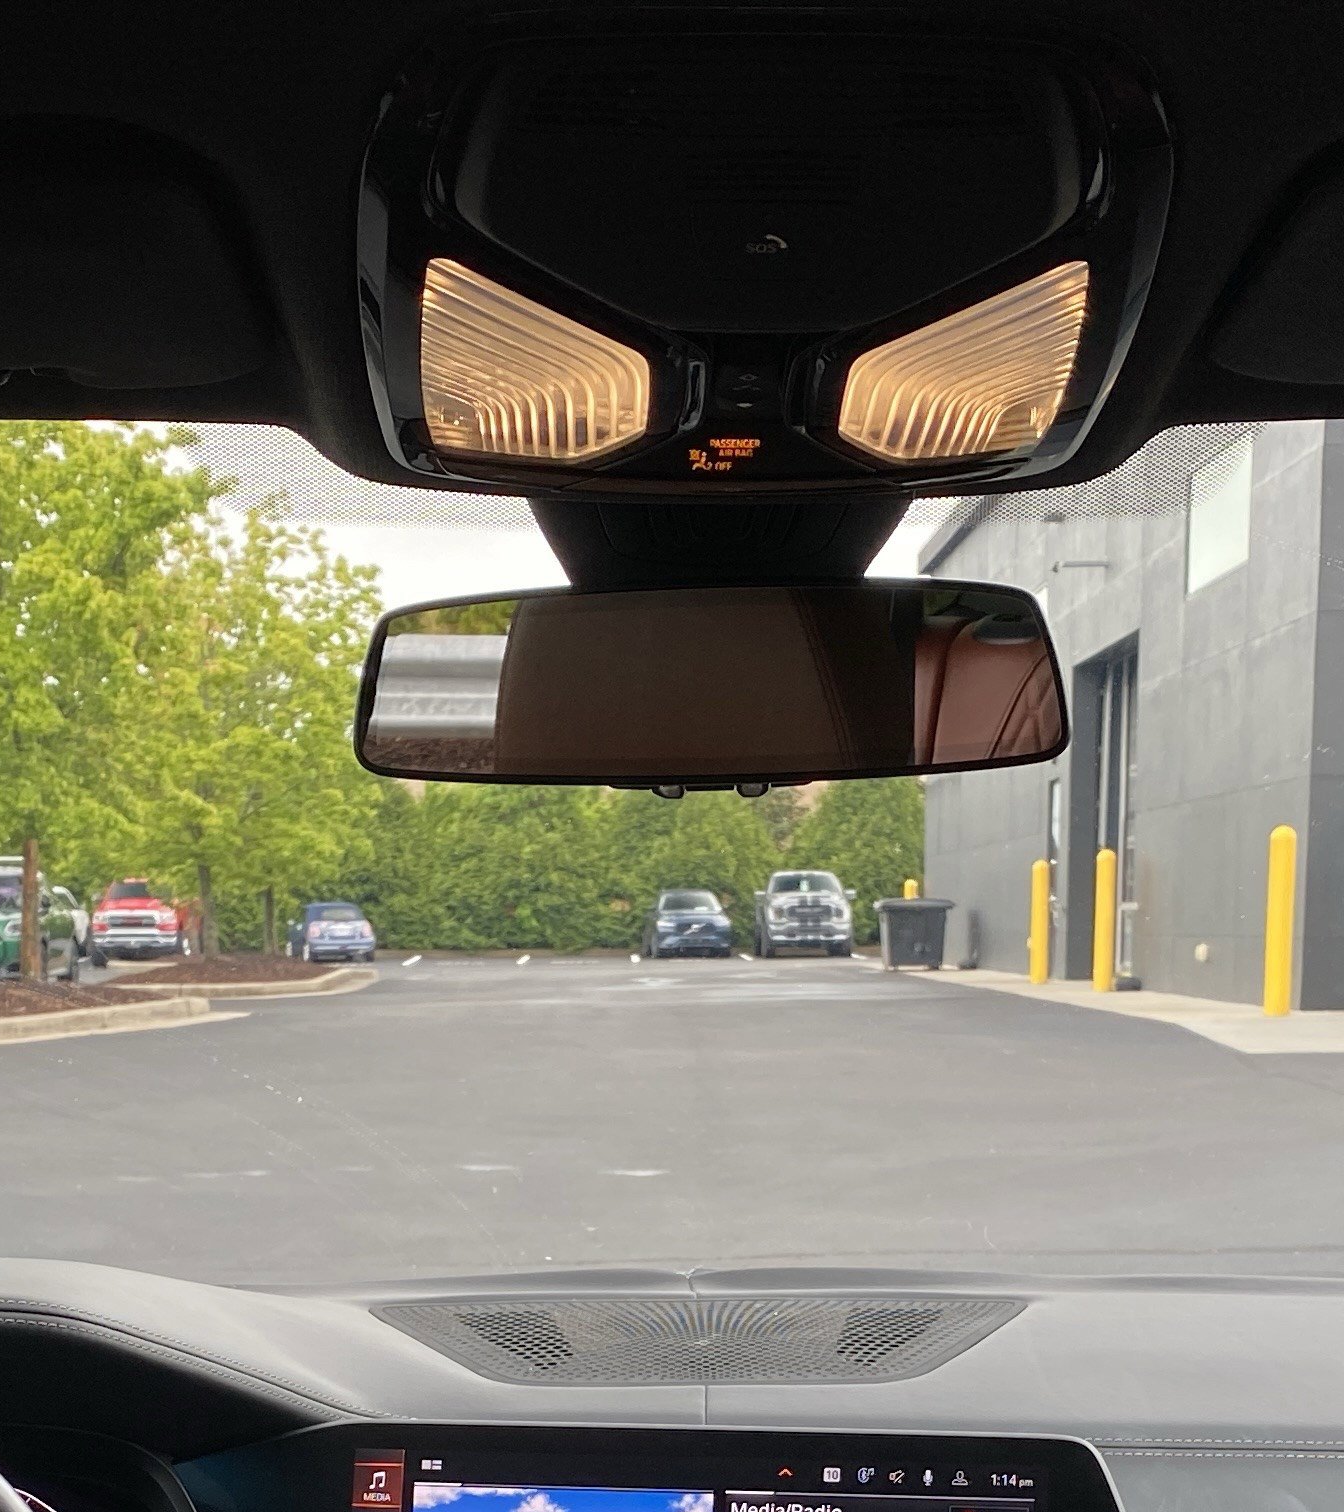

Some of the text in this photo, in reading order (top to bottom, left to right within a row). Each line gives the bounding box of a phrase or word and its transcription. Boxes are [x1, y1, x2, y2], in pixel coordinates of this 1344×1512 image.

[710, 439, 761, 448] PASSENGER
[826, 1470, 839, 1481] 10
[991, 1474, 1034, 1488] 1:14 pm
[363, 1493, 391, 1502] MEDIA
